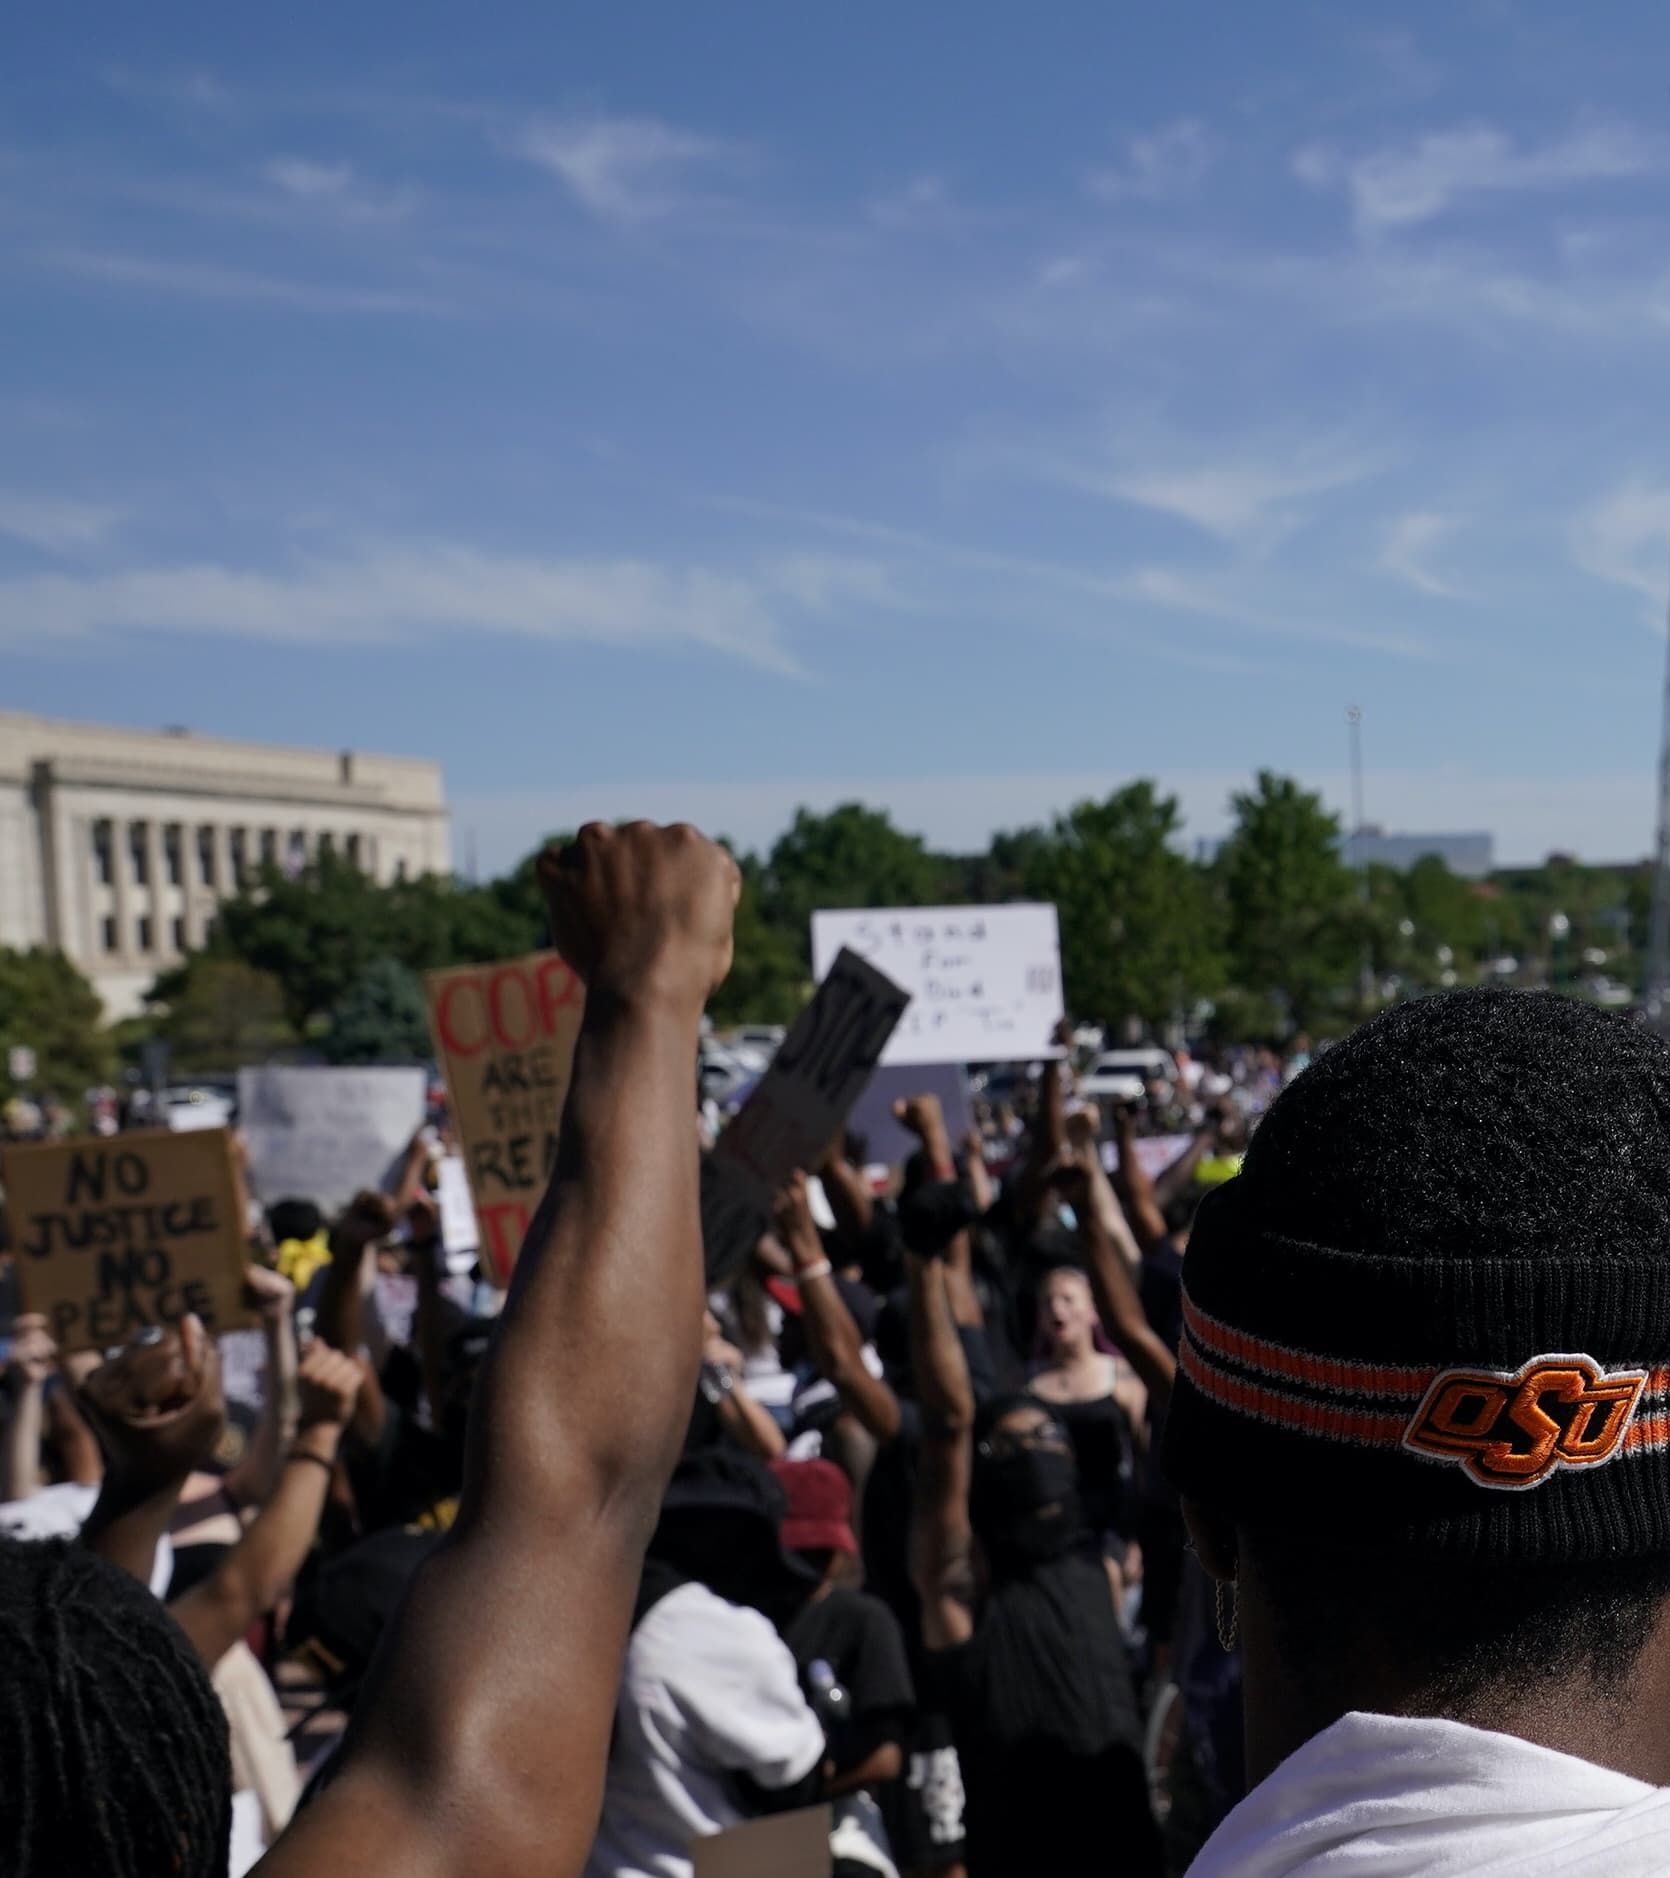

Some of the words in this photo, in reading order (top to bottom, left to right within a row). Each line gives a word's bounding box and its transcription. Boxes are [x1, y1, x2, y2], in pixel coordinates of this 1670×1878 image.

[437, 957, 580, 1057] COP
[482, 1046, 559, 1092] ARE
[67, 1151, 151, 1204] NO
[23, 1197, 219, 1259] JUSTICE
[97, 1249, 172, 1300] NO
[52, 1280, 216, 1346] PEACE
[1404, 1355, 1647, 1487] OSU
